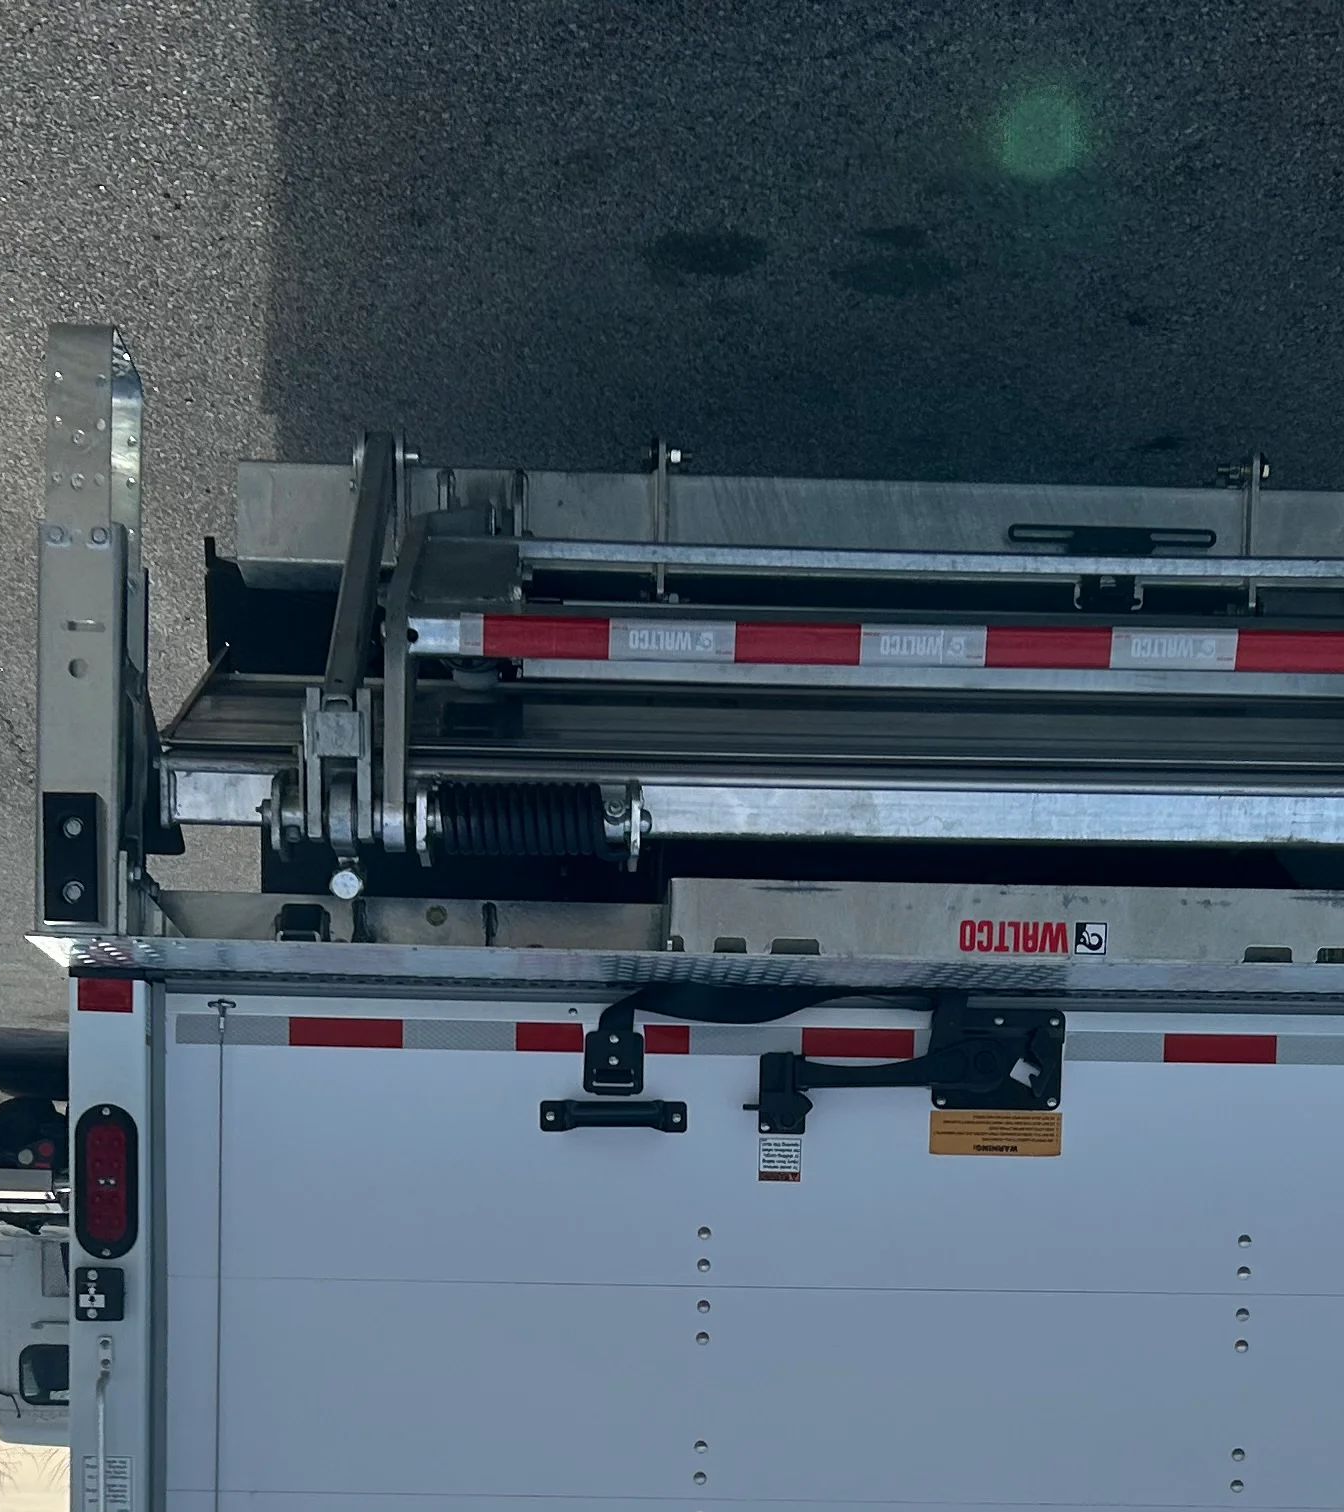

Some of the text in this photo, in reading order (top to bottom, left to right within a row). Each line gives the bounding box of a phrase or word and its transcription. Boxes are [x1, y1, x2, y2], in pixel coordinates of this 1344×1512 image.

[629, 629, 691, 651] WALTCO
[880, 635, 942, 656] WALTCO
[1131, 638, 1194, 659] WALTCO
[959, 919, 1069, 954] WALTCO
